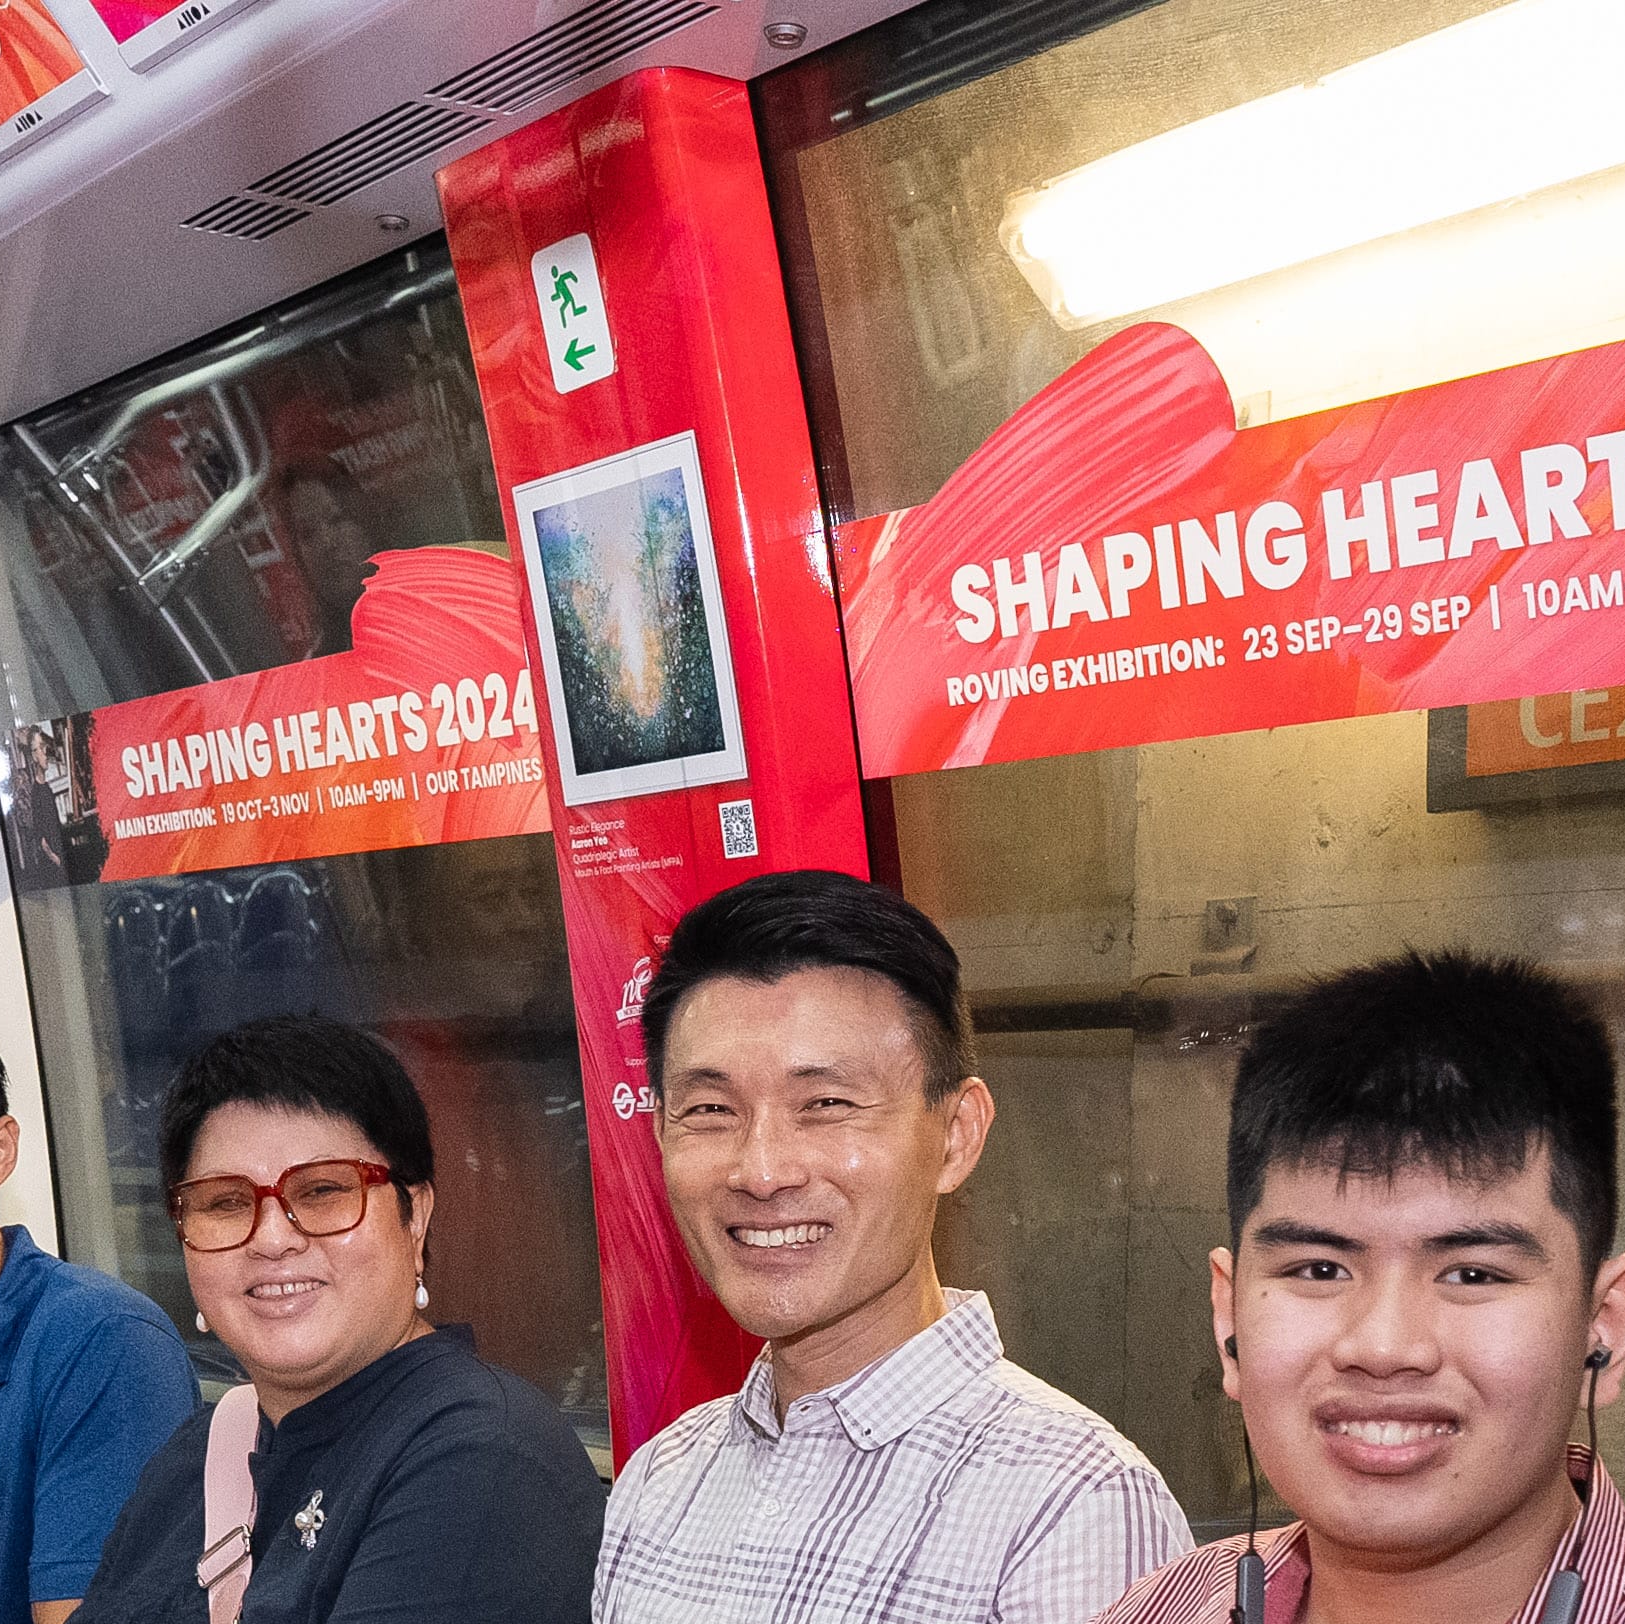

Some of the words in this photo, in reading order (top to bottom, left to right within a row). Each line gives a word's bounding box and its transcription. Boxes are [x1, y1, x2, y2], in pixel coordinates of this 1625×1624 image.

[950, 500, 1308, 645] SHAPING
[946, 662, 1049, 707] ROVING
[1051, 635, 1226, 691] EXHIBITION:
[1242, 624, 1280, 662] 23
[1409, 595, 1472, 638] SEP
[121, 721, 273, 799] SHAPING
[272, 691, 429, 774] HEARTS
[430, 669, 539, 748] 2024
[114, 818, 147, 841] MAIN
[146, 806, 217, 836] EXHIBITION:
[221, 804, 236, 825] 19
[281, 791, 310, 815] NOV
[426, 768, 460, 796] OUR
[460, 758, 543, 790] TAMPINES
[591, 819, 624, 834] Elegance
[571, 837, 594, 850] Aaron
[594, 835, 608, 847] Yeo
[572, 850, 618, 866] Quadriplegic
[618, 846, 640, 859] Artist
